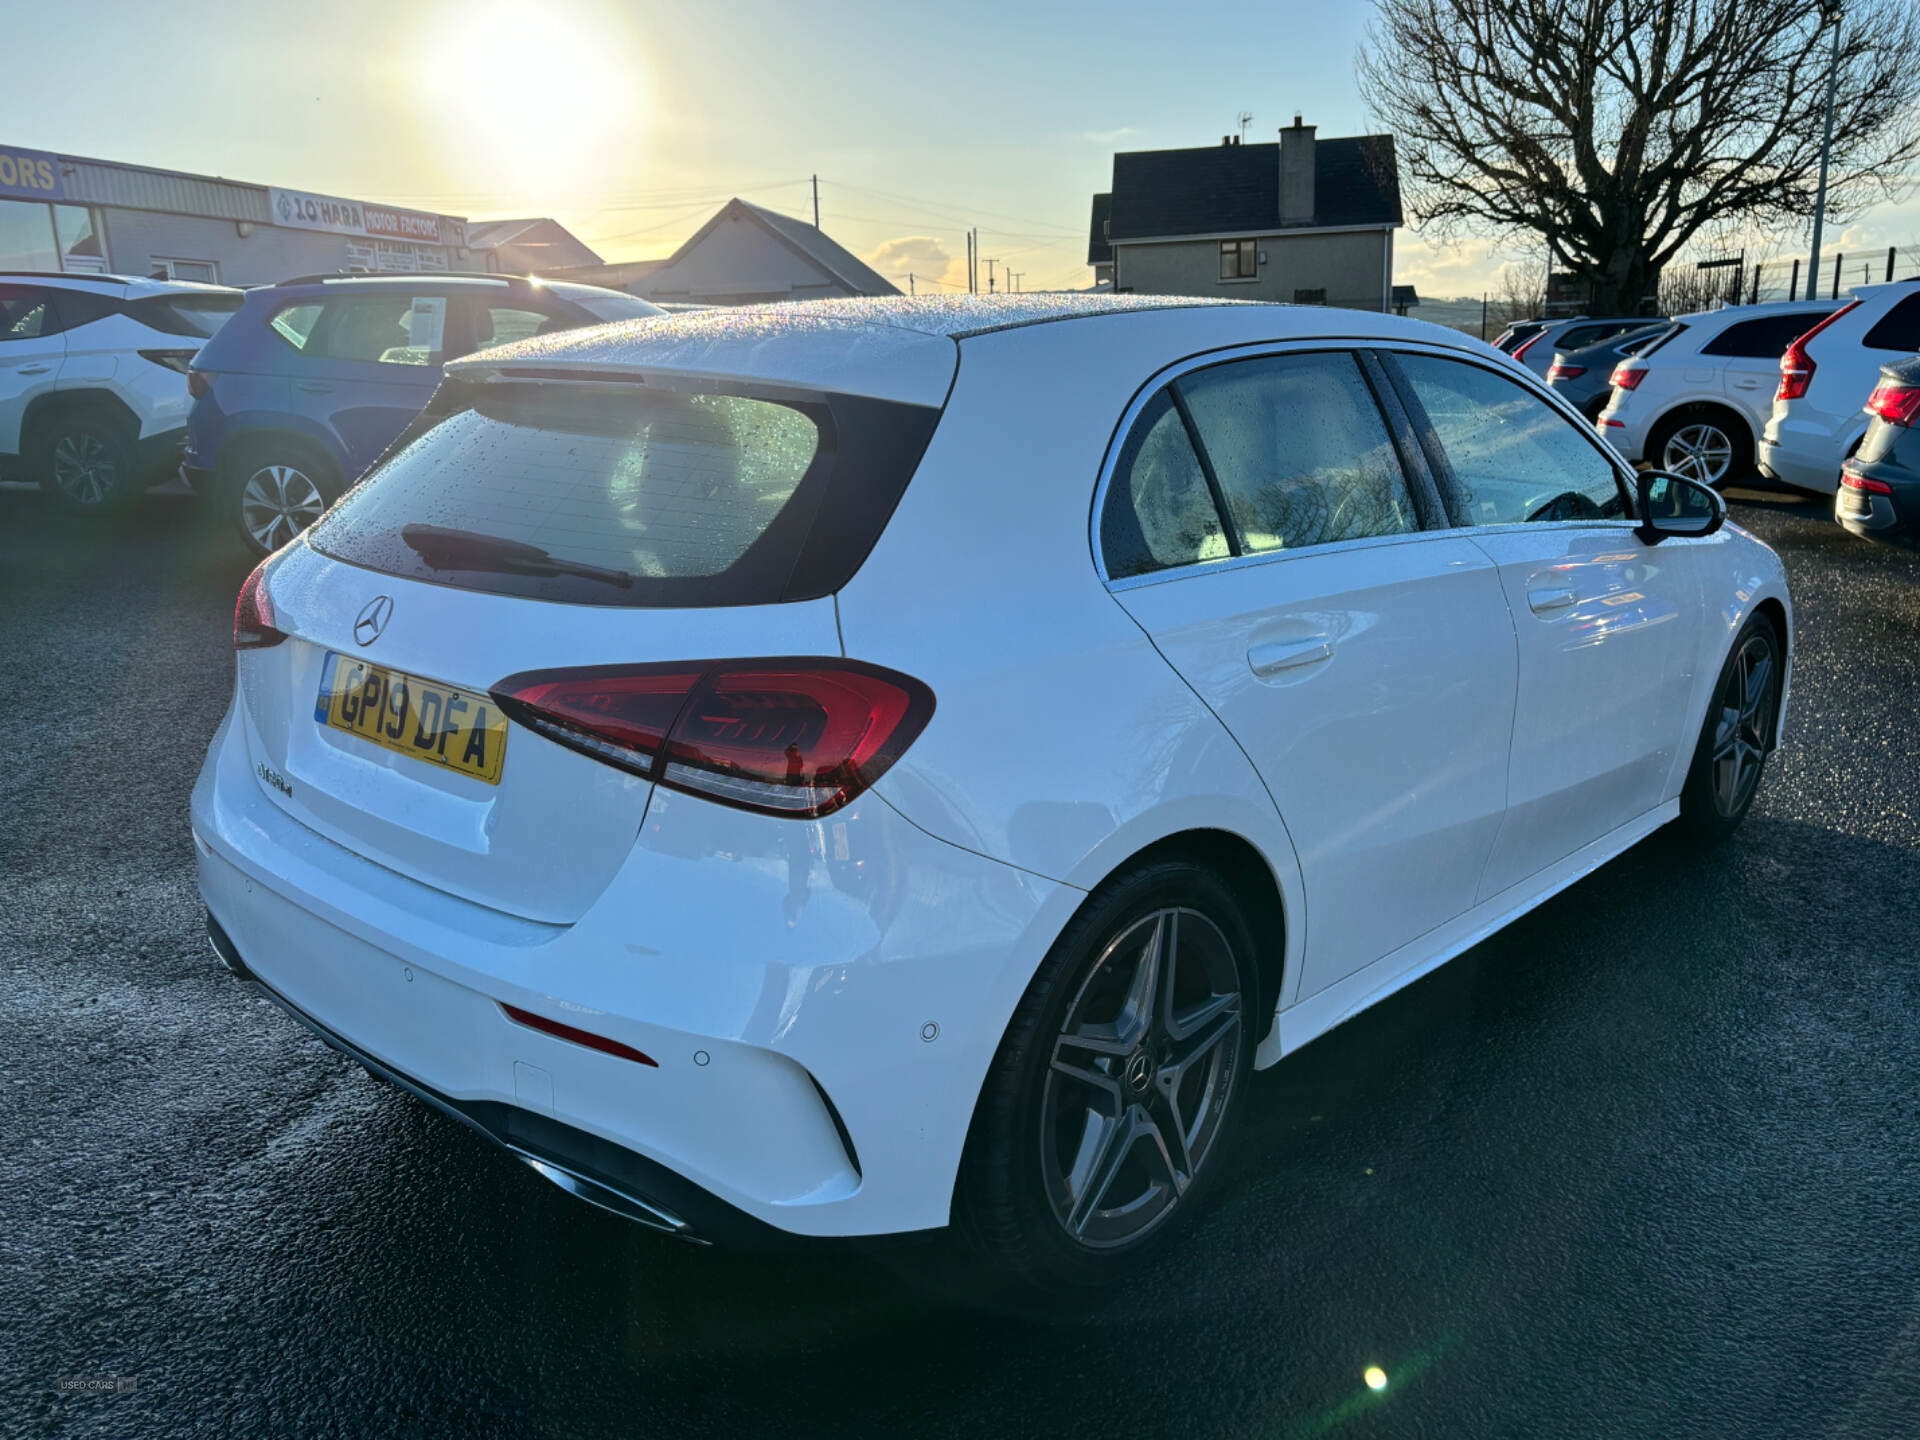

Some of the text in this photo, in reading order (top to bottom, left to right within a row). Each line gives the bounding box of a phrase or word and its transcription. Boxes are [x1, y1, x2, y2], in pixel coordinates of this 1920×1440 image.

[0, 155, 55, 191] ORS
[366, 210, 399, 233] MOTOR
[400, 216, 438, 238] FACTORS
[340, 667, 487, 769] GP19 DFA
